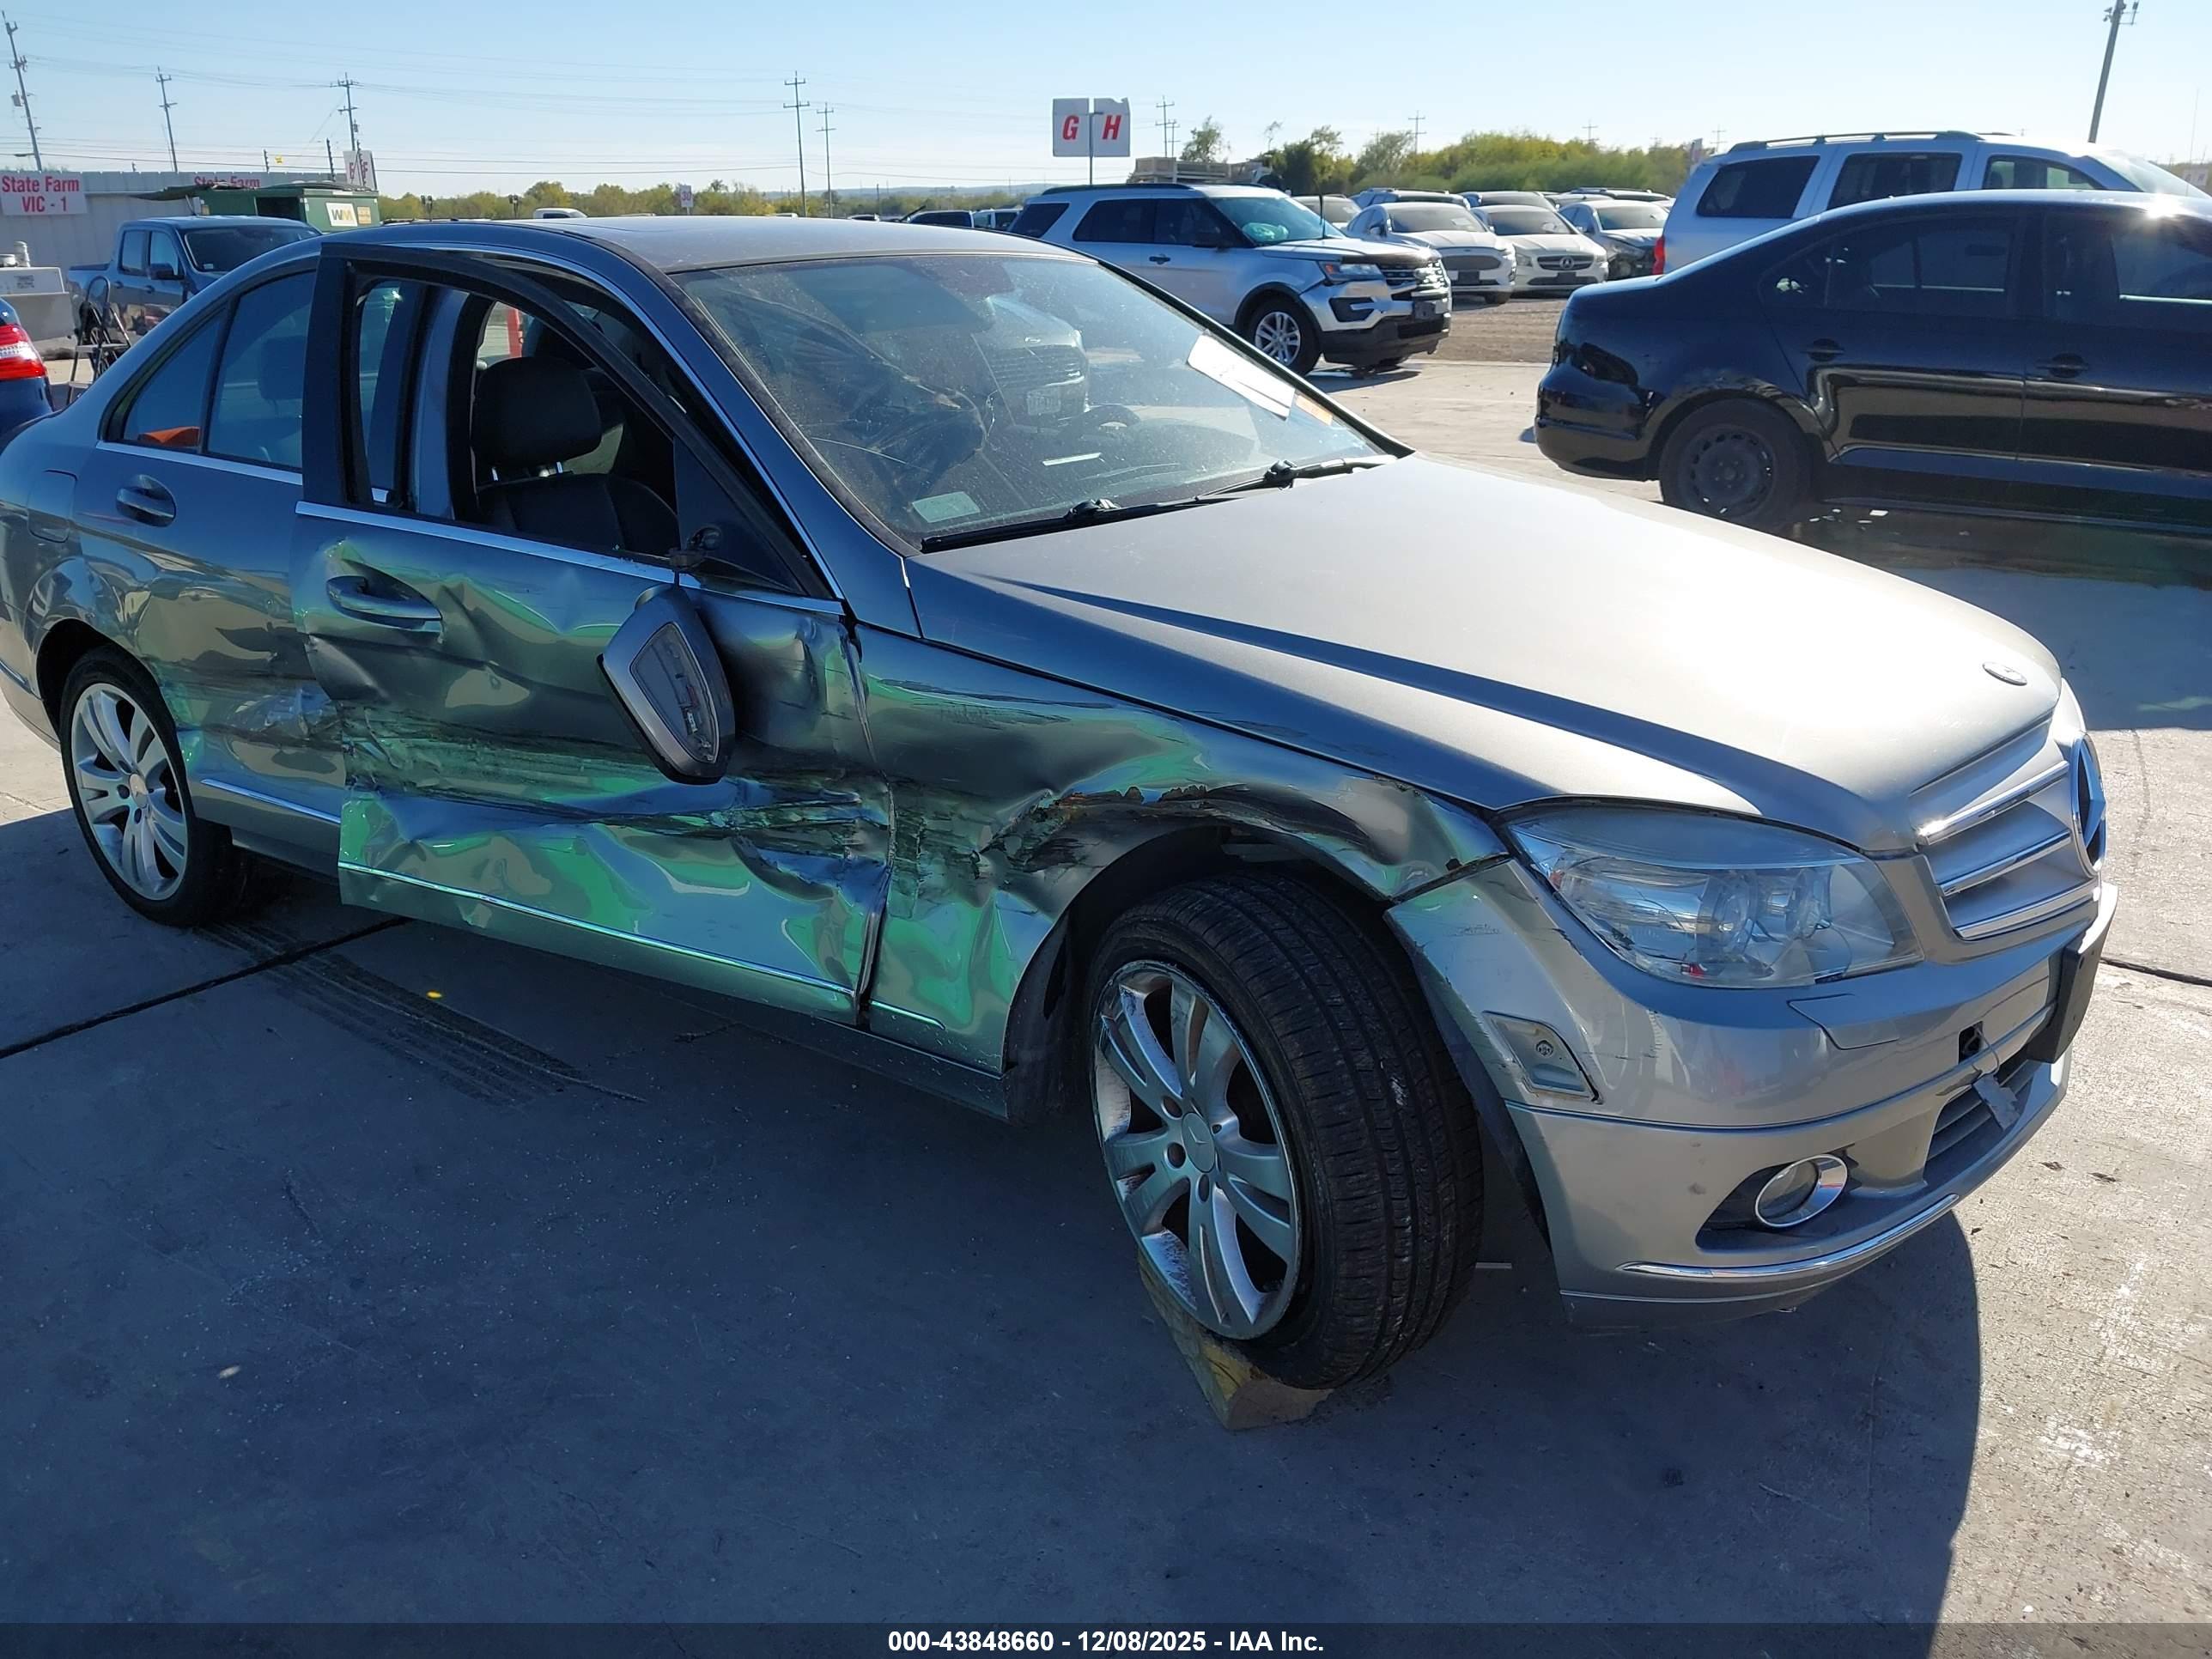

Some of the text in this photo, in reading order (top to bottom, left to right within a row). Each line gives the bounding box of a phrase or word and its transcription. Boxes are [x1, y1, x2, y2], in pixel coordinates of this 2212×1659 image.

[1062, 115, 1121, 140] G H
[2, 175, 80, 192] State Farm
[230, 175, 261, 188] Farm
[21, 195, 46, 213] VIC
[60, 196, 66, 212] 1
[331, 209, 353, 221] WM
